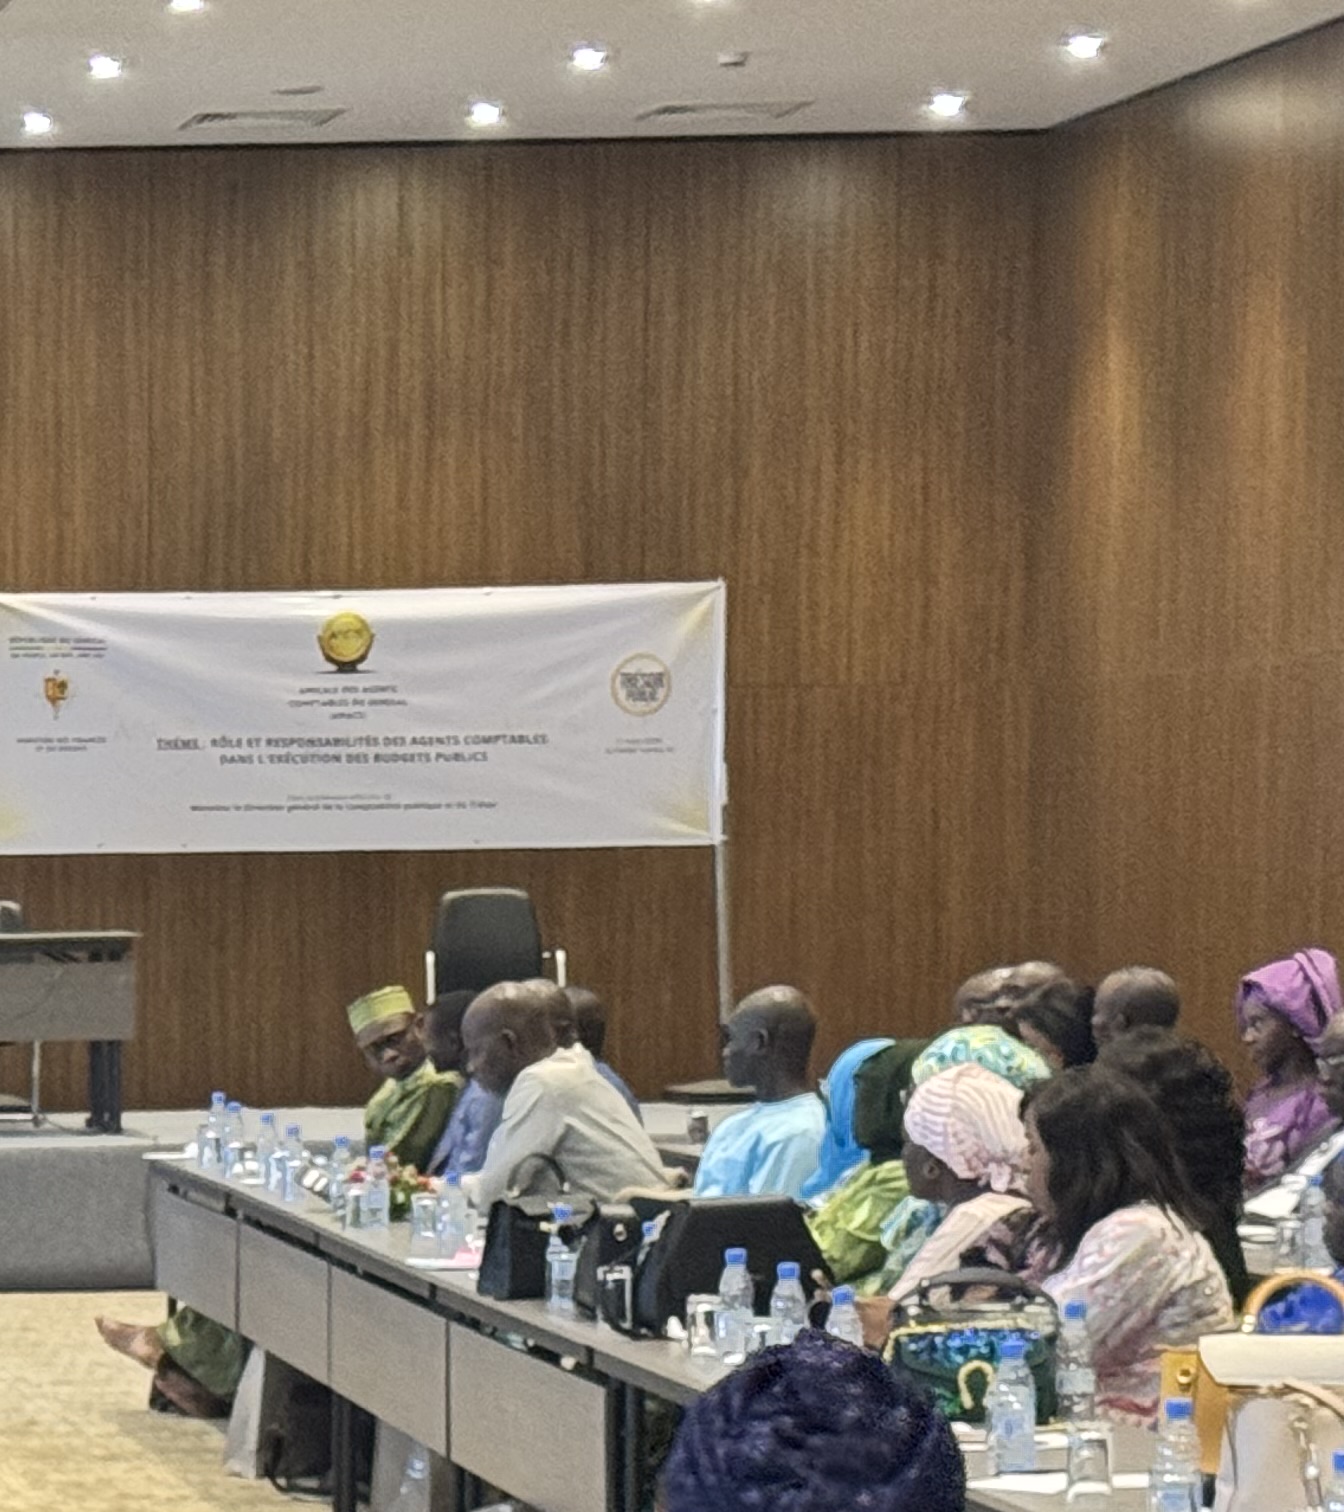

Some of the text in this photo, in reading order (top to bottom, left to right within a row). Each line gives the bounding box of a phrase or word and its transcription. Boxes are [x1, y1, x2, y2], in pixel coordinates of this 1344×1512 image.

[211, 735, 243, 749] RÔLE
[246, 737, 262, 748] ET
[265, 735, 380, 748] RESPONSABILITÉS
[382, 735, 407, 747] DES
[411, 734, 462, 747] AGENTS
[463, 733, 549, 746] COMPTABLES
[220, 751, 489, 765] DANS L'EXÉCUTION DES BUDGETS PUBLICS
